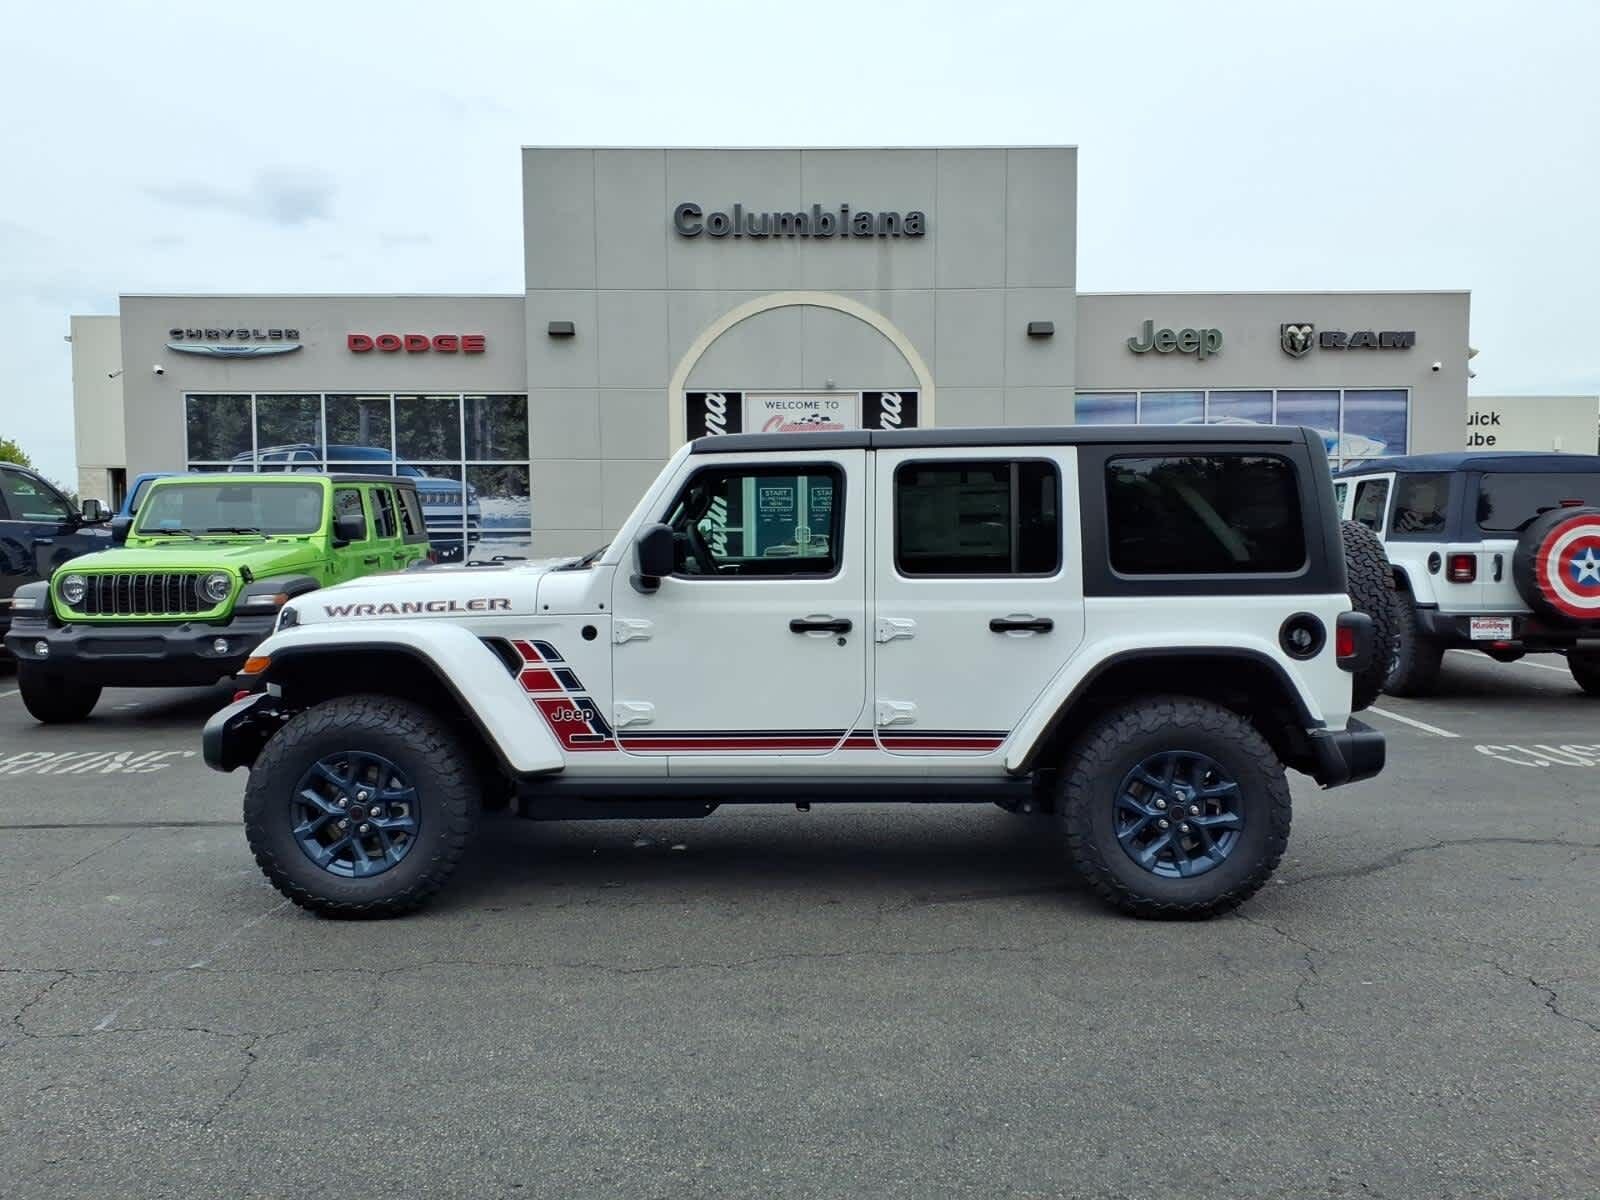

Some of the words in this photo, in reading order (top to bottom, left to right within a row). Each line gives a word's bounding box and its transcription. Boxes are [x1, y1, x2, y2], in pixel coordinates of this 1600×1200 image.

[674, 203, 926, 239] Columbiana
[169, 328, 300, 340] CHRYSLER
[347, 334, 486, 353] DODGE
[1128, 319, 1223, 360] Jeep
[1319, 330, 1416, 350] RAM
[764, 401, 820, 410] WELCOME
[824, 401, 840, 410] TO
[323, 598, 512, 617] WRANGLER
[551, 706, 594, 724] Jeep
